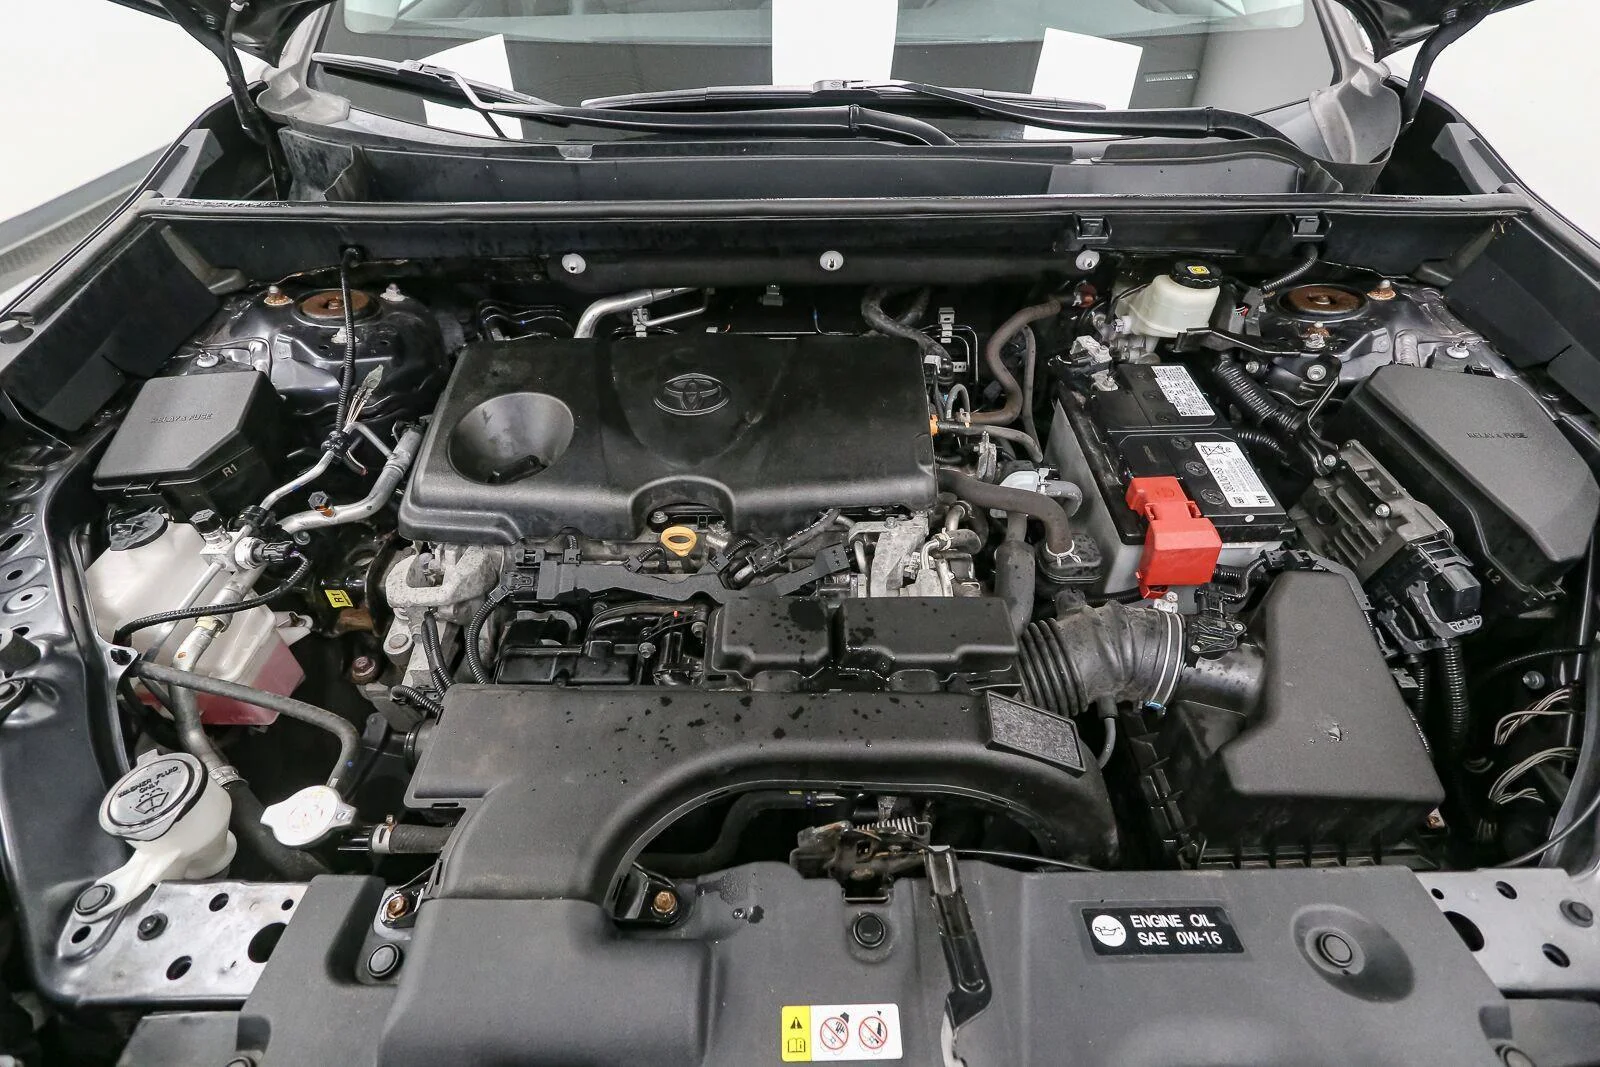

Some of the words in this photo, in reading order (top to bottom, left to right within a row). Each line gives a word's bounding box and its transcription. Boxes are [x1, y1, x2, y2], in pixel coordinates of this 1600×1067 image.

[221, 462, 238, 477] R1
[330, 591, 344, 603] R1
[156, 765, 179, 780] FLUID
[138, 779, 160, 795] ONLY
[1129, 913, 1184, 928] ENGINE
[1189, 913, 1216, 927] OIL
[1136, 931, 1170, 946] SAE
[1175, 930, 1223, 945] 0W-16
